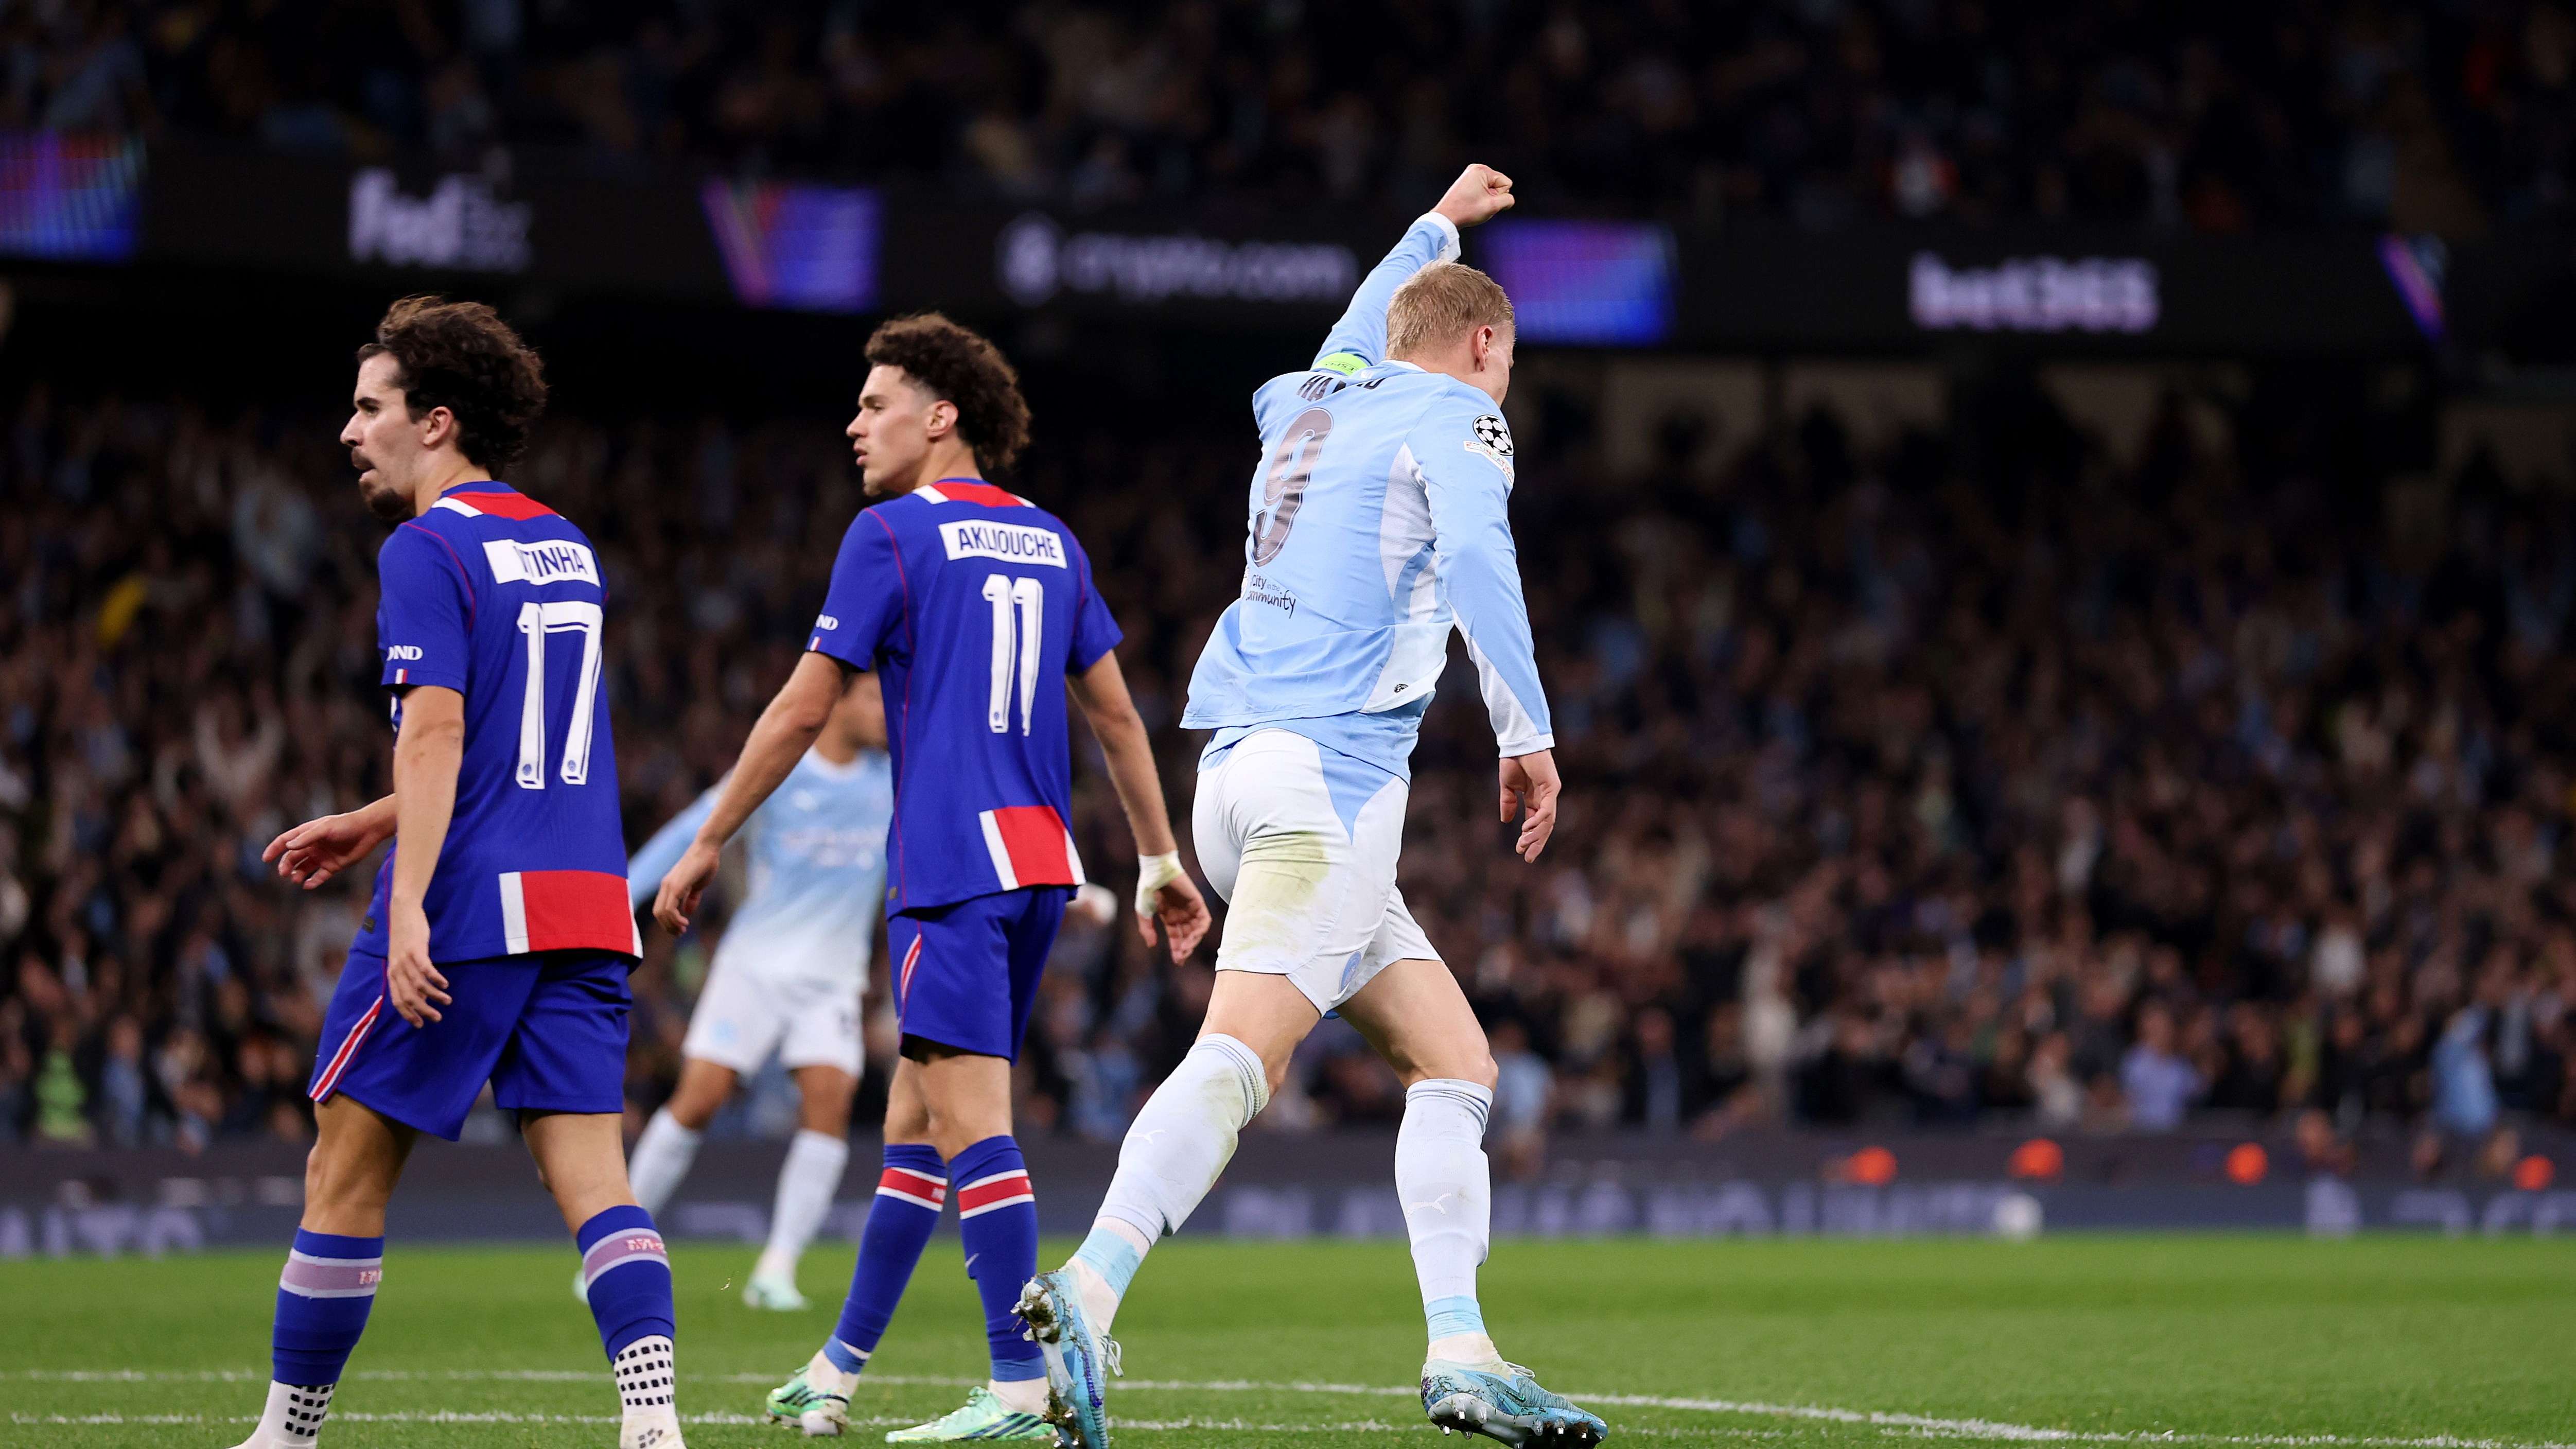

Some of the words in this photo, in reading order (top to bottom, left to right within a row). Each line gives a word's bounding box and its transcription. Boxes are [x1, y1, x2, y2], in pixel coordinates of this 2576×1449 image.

[959, 527, 1058, 558] AKLIOUCHE
[1253, 407, 1334, 567] 9
[982, 574, 1043, 737] 11
[1252, 574, 1267, 590] City
[516, 601, 603, 789] 17
